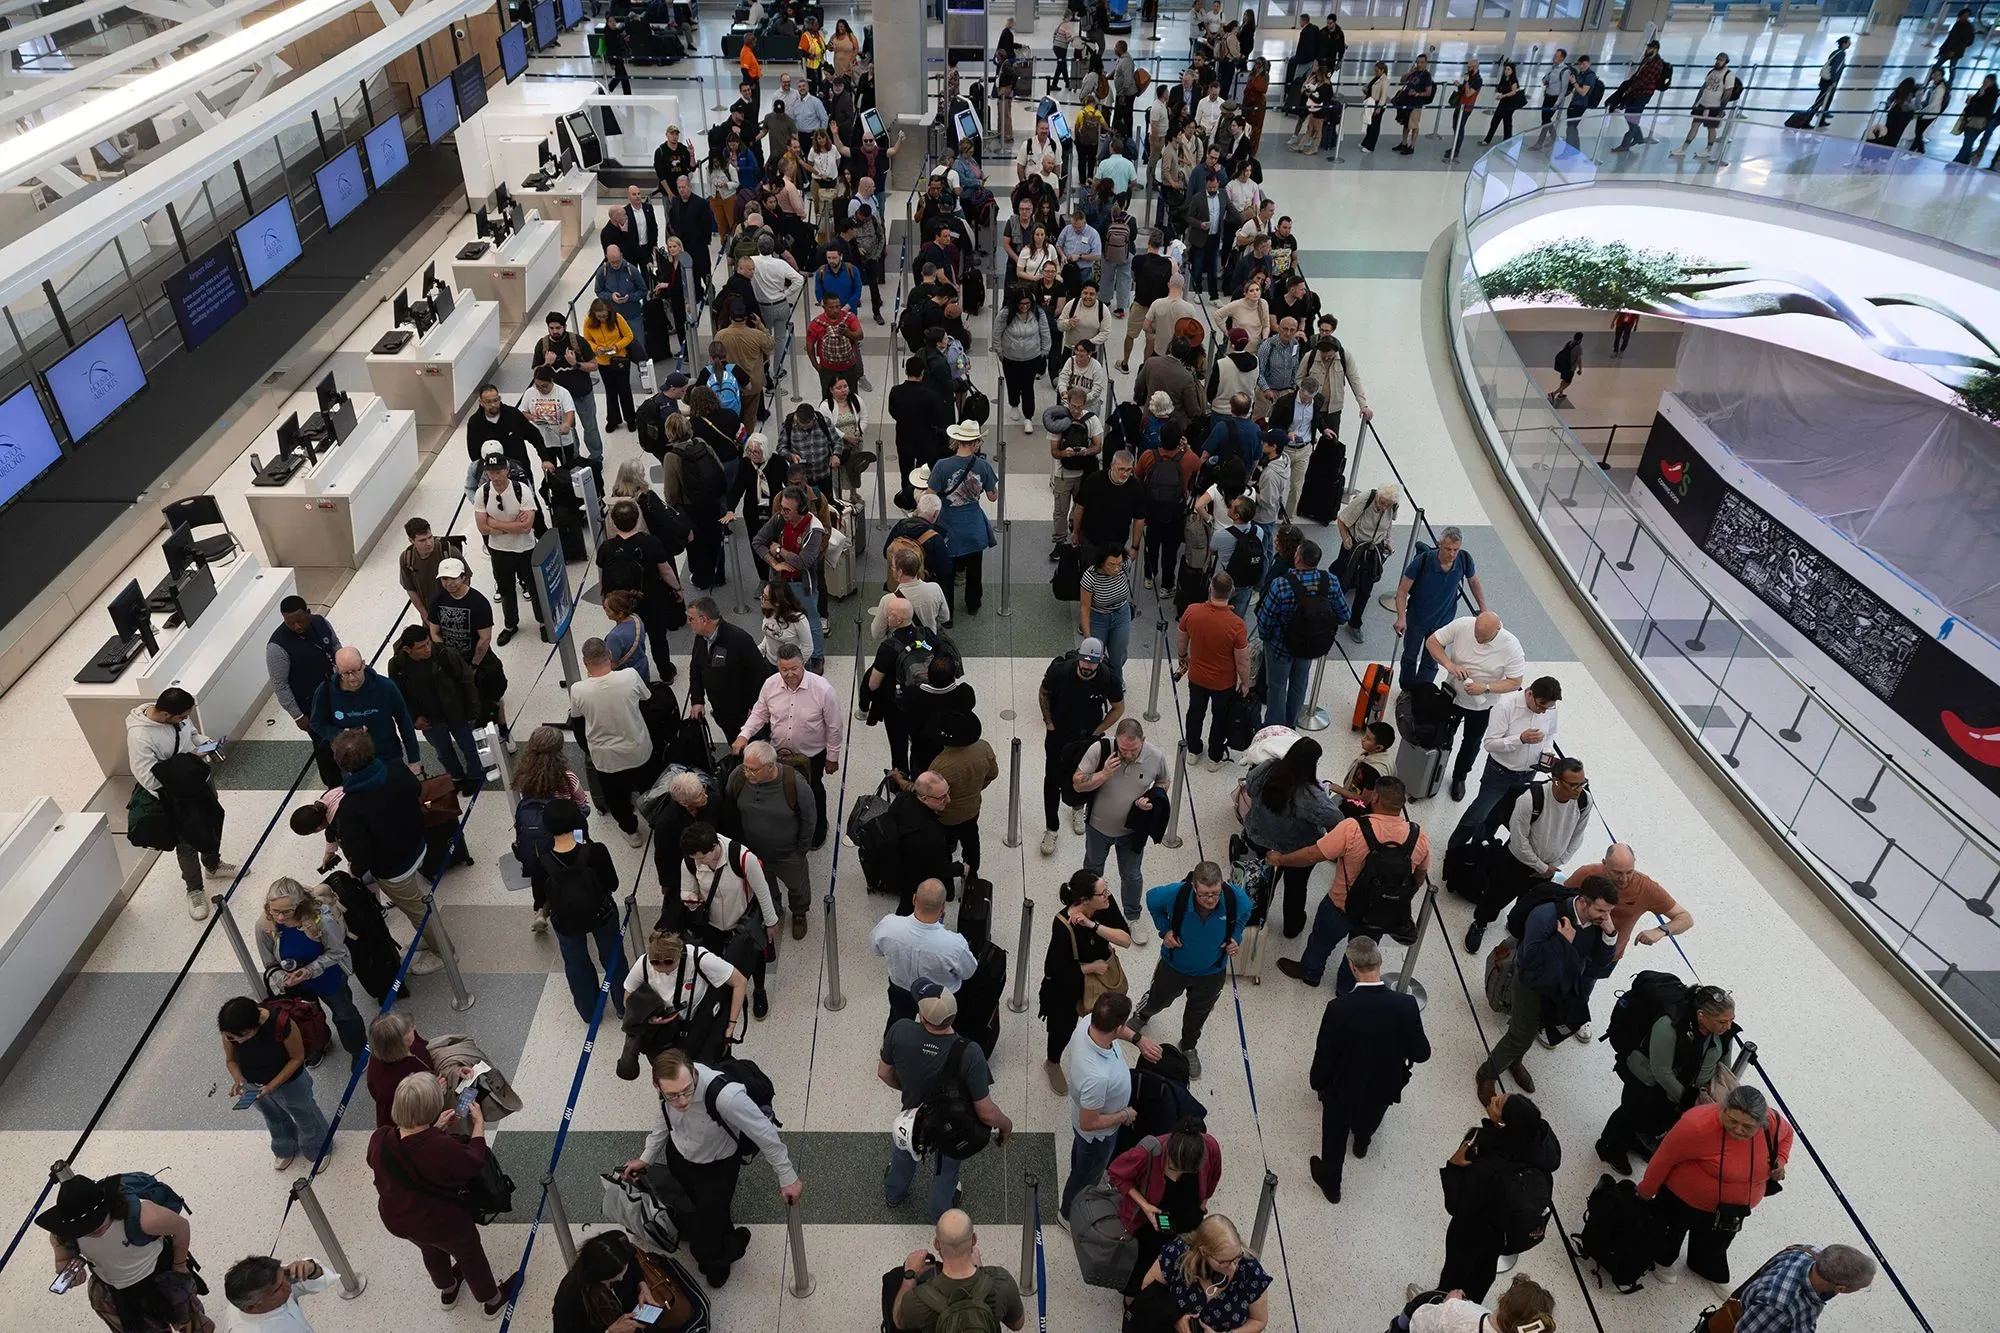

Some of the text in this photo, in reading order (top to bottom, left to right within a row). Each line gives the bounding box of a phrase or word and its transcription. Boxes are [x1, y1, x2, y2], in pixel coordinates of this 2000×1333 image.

[391, 979, 401, 992] IAH
[601, 981, 611, 993] IAH
[584, 1041, 594, 1053] IAH
[336, 1104, 345, 1118] IAH
[563, 1107, 573, 1121] IAH
[505, 1304, 514, 1321] IAH
